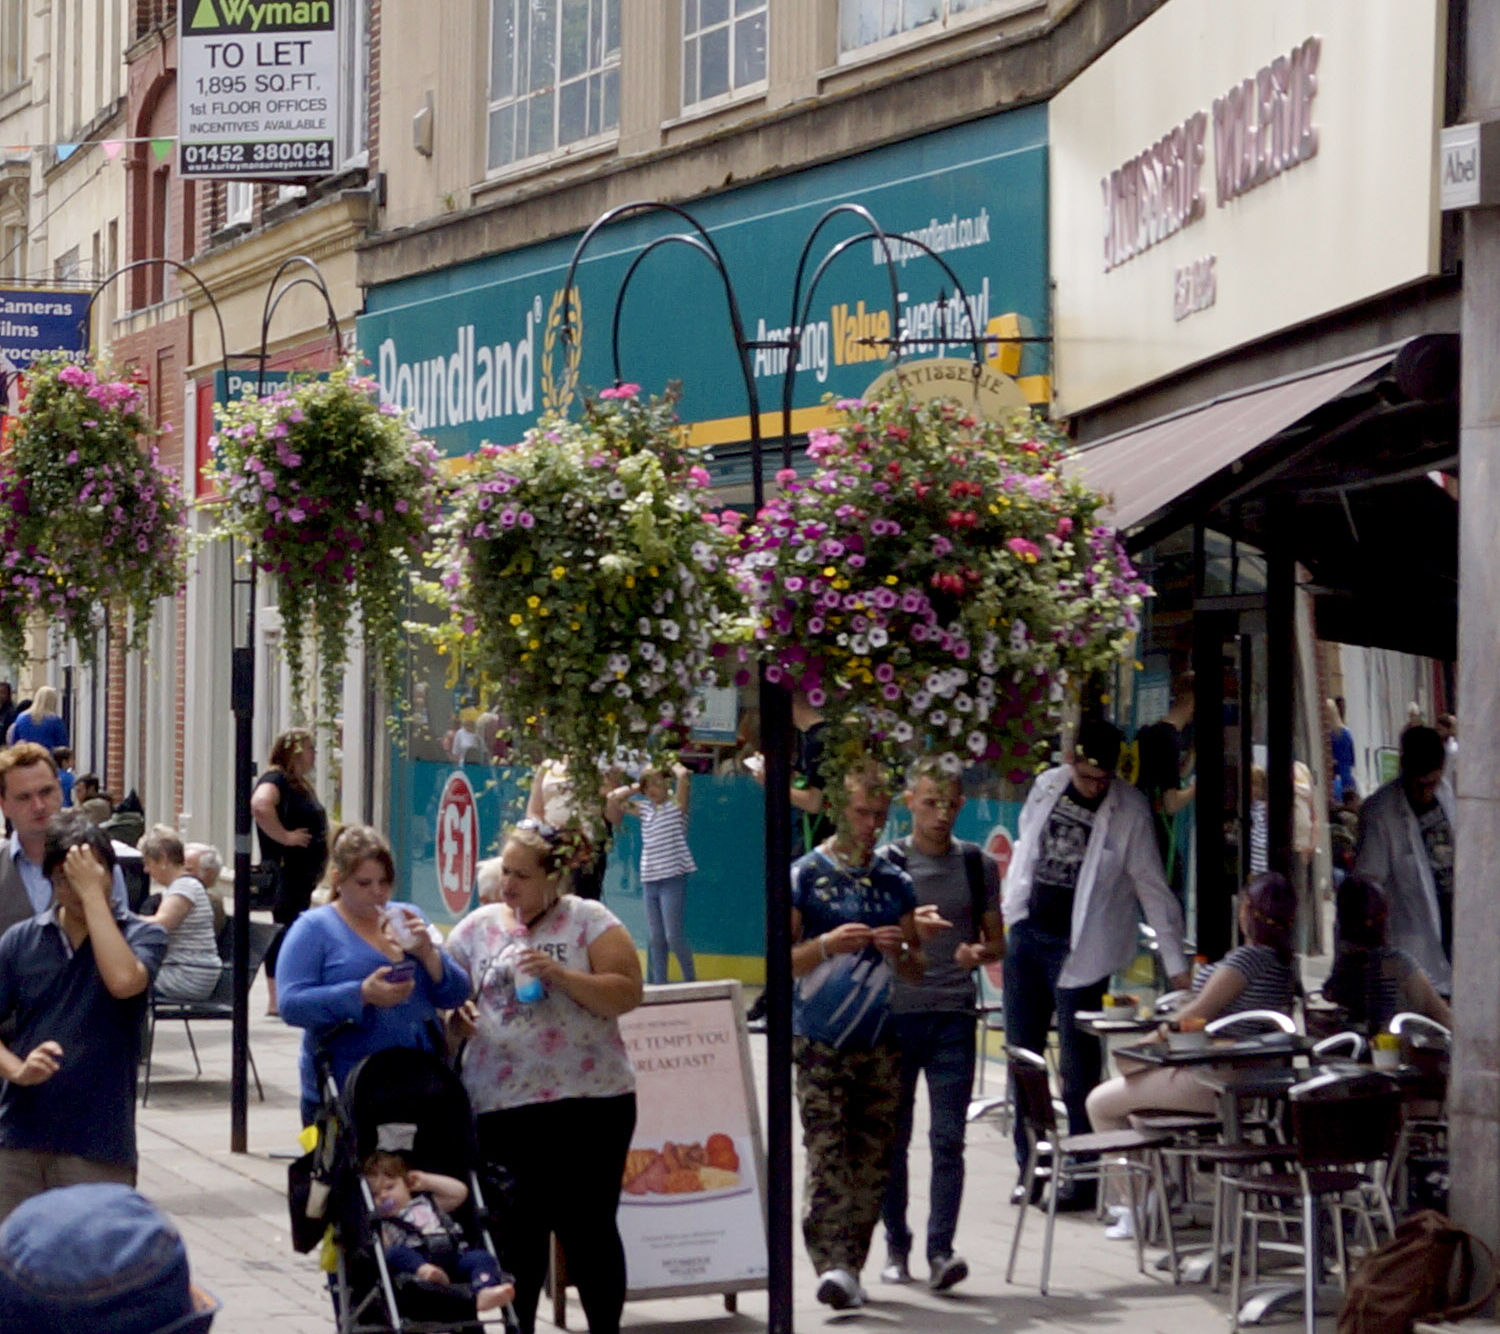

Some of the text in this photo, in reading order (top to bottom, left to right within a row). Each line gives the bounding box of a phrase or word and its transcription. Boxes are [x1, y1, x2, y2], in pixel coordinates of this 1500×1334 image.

[204, 41, 312, 68] TO LET
[196, 75, 246, 96] 1,895
[190, 99, 327, 115] 1st FLOOR OFFICES
[189, 118, 326, 134] INCENTIVES AVAILABLE
[185, 142, 330, 162] 01452 380064
[1445, 148, 1477, 185] Abel
[831, 301, 890, 365] Value
[379, 310, 534, 431] Poundland
[646, 1034, 691, 1048] TEMPT
